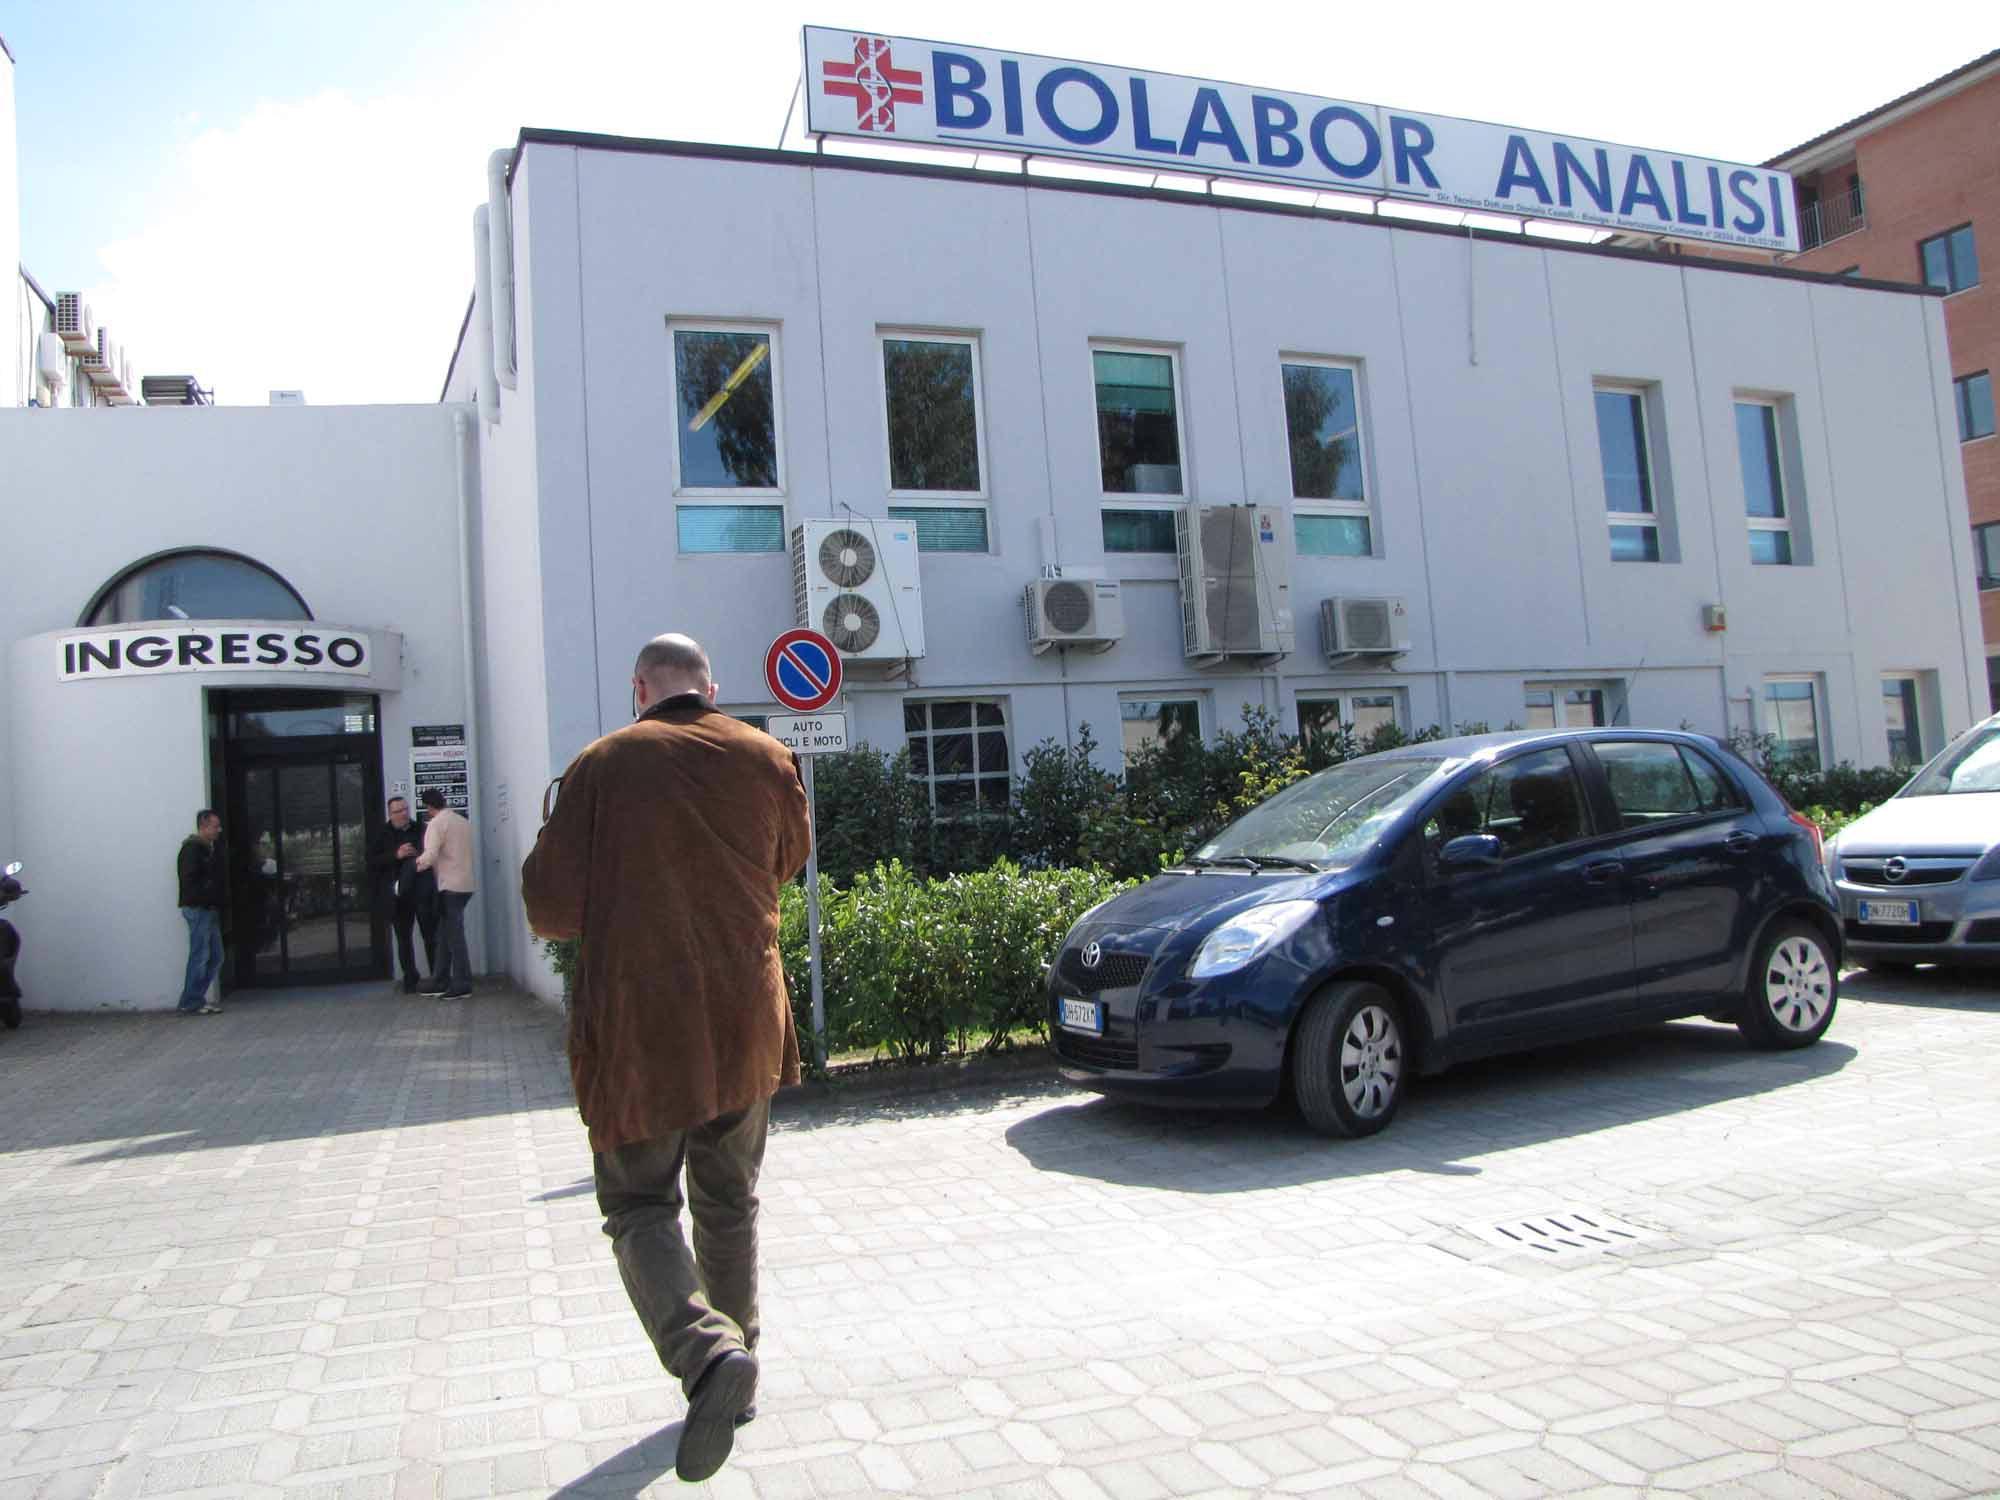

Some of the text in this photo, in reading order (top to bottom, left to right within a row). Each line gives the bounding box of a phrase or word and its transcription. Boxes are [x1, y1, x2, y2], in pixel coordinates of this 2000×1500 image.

[931, 50, 1785, 238] BIOLABOR ANALISI
[64, 633, 365, 674] INGRESSO
[792, 721, 823, 732] AUTO
[802, 736, 810, 747] E
[814, 735, 842, 747] MOTO
